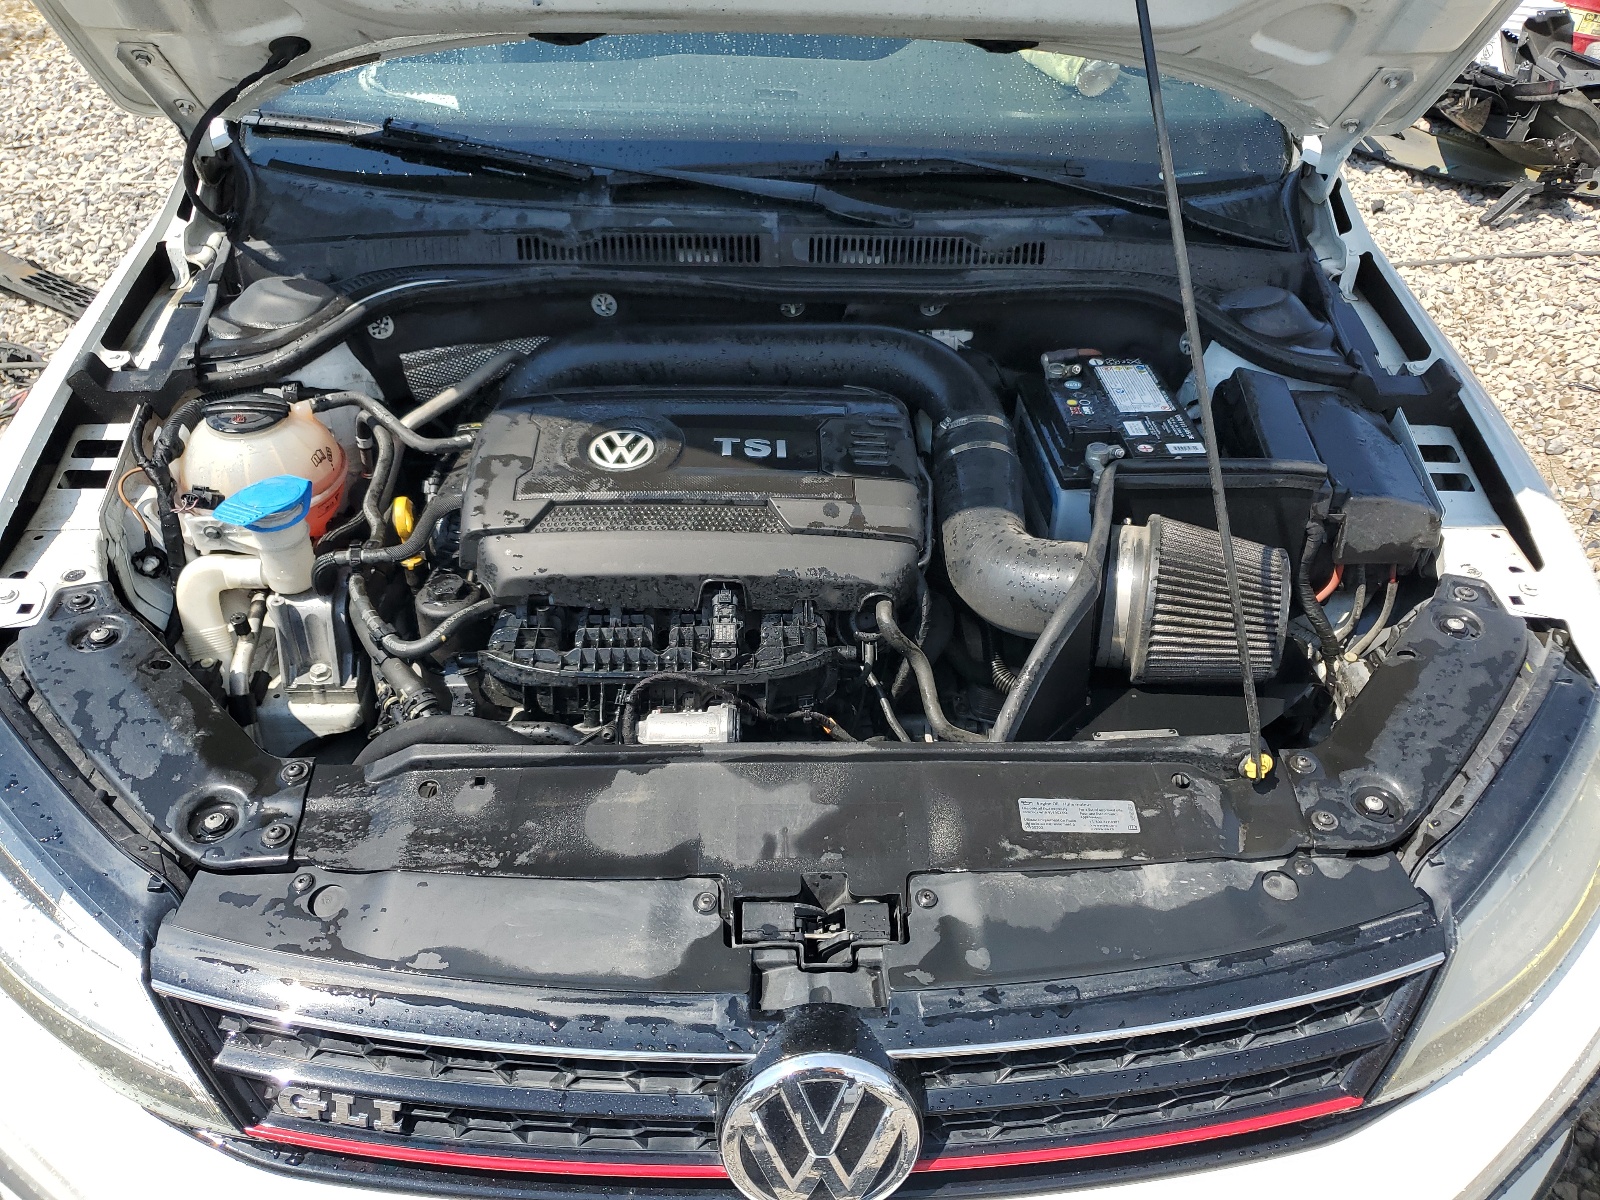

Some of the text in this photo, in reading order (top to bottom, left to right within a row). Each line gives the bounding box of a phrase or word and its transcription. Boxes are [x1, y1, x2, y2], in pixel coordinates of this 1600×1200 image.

[589, 430, 655, 469] VW
[713, 437, 787, 458] TSI
[278, 1086, 402, 1132] GLI
[726, 1060, 918, 1200] VW
